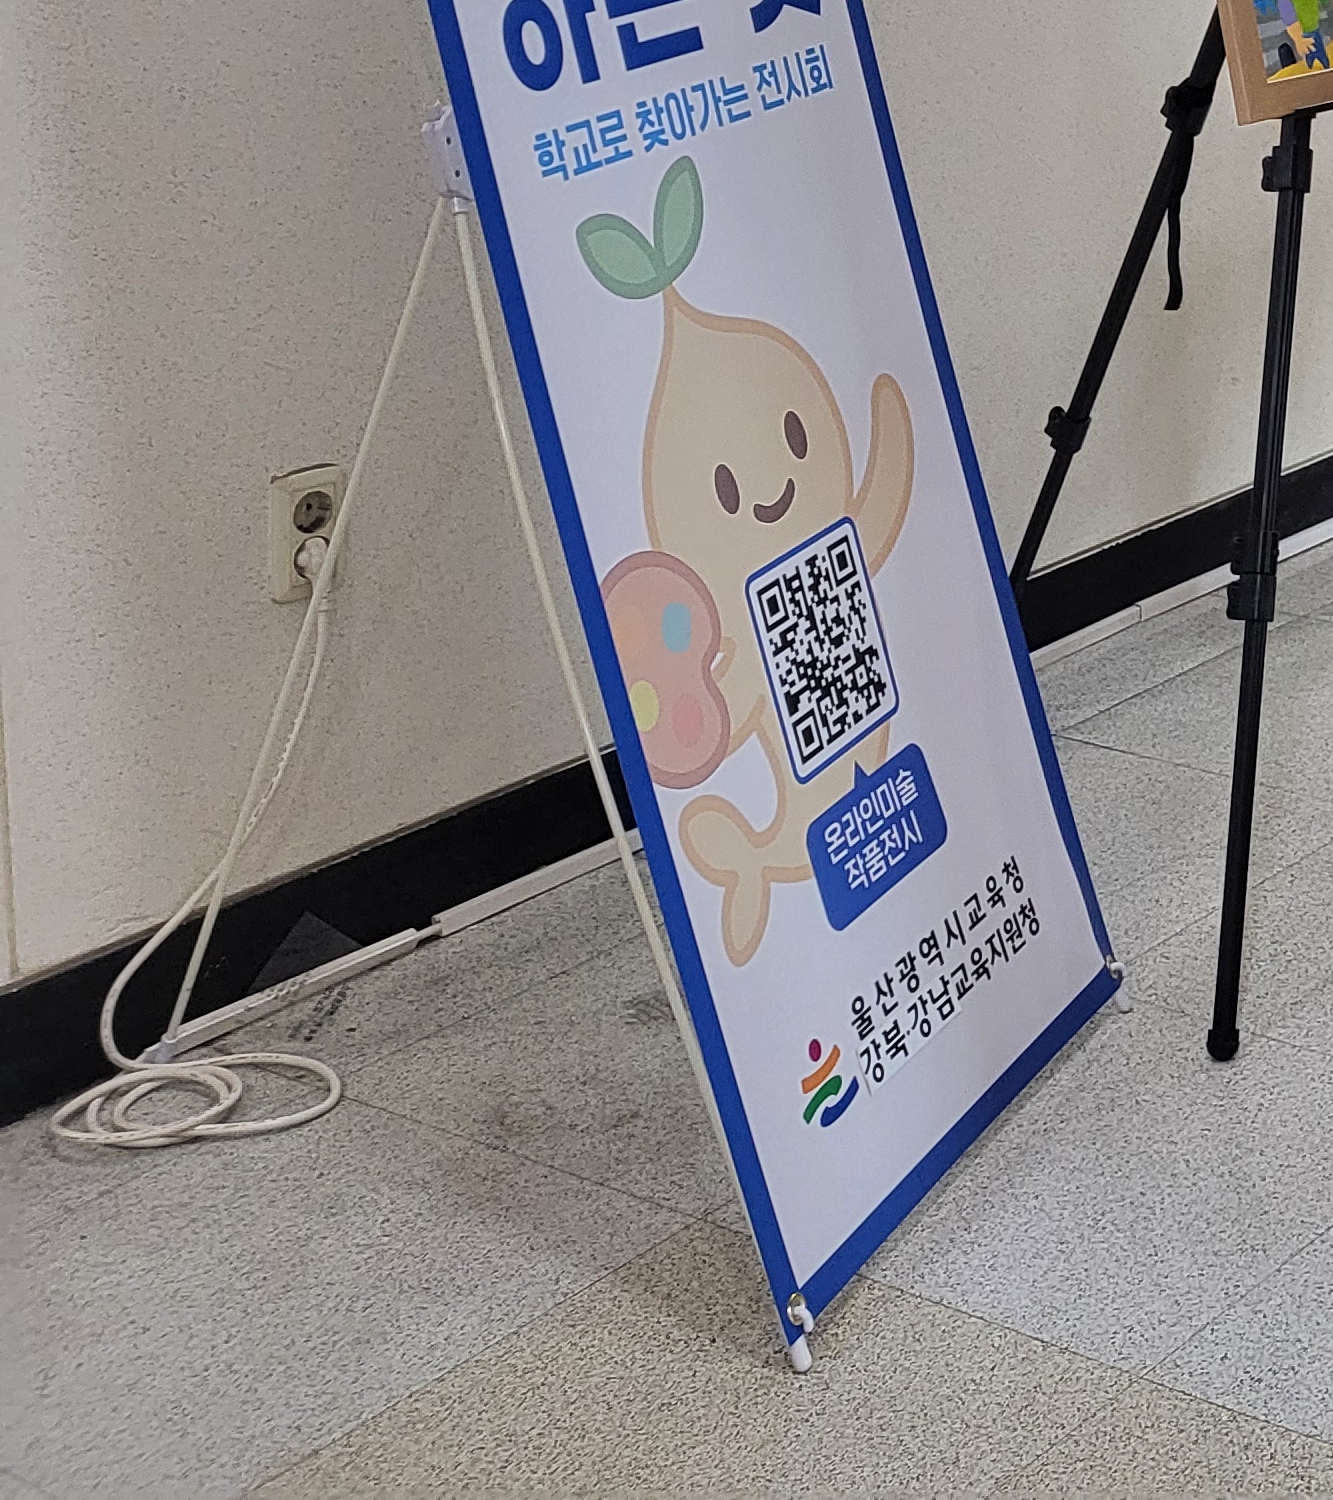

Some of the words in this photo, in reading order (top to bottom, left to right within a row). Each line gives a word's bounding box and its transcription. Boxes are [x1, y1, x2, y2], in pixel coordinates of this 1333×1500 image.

[533, 109, 634, 181] 학교로
[635, 76, 752, 153] 찾아가는
[752, 43, 834, 111] 전시회
[824, 768, 919, 865] 온라인미술
[844, 809, 923, 890] 작품전시
[851, 855, 1024, 1041] 울산광역시교육청
